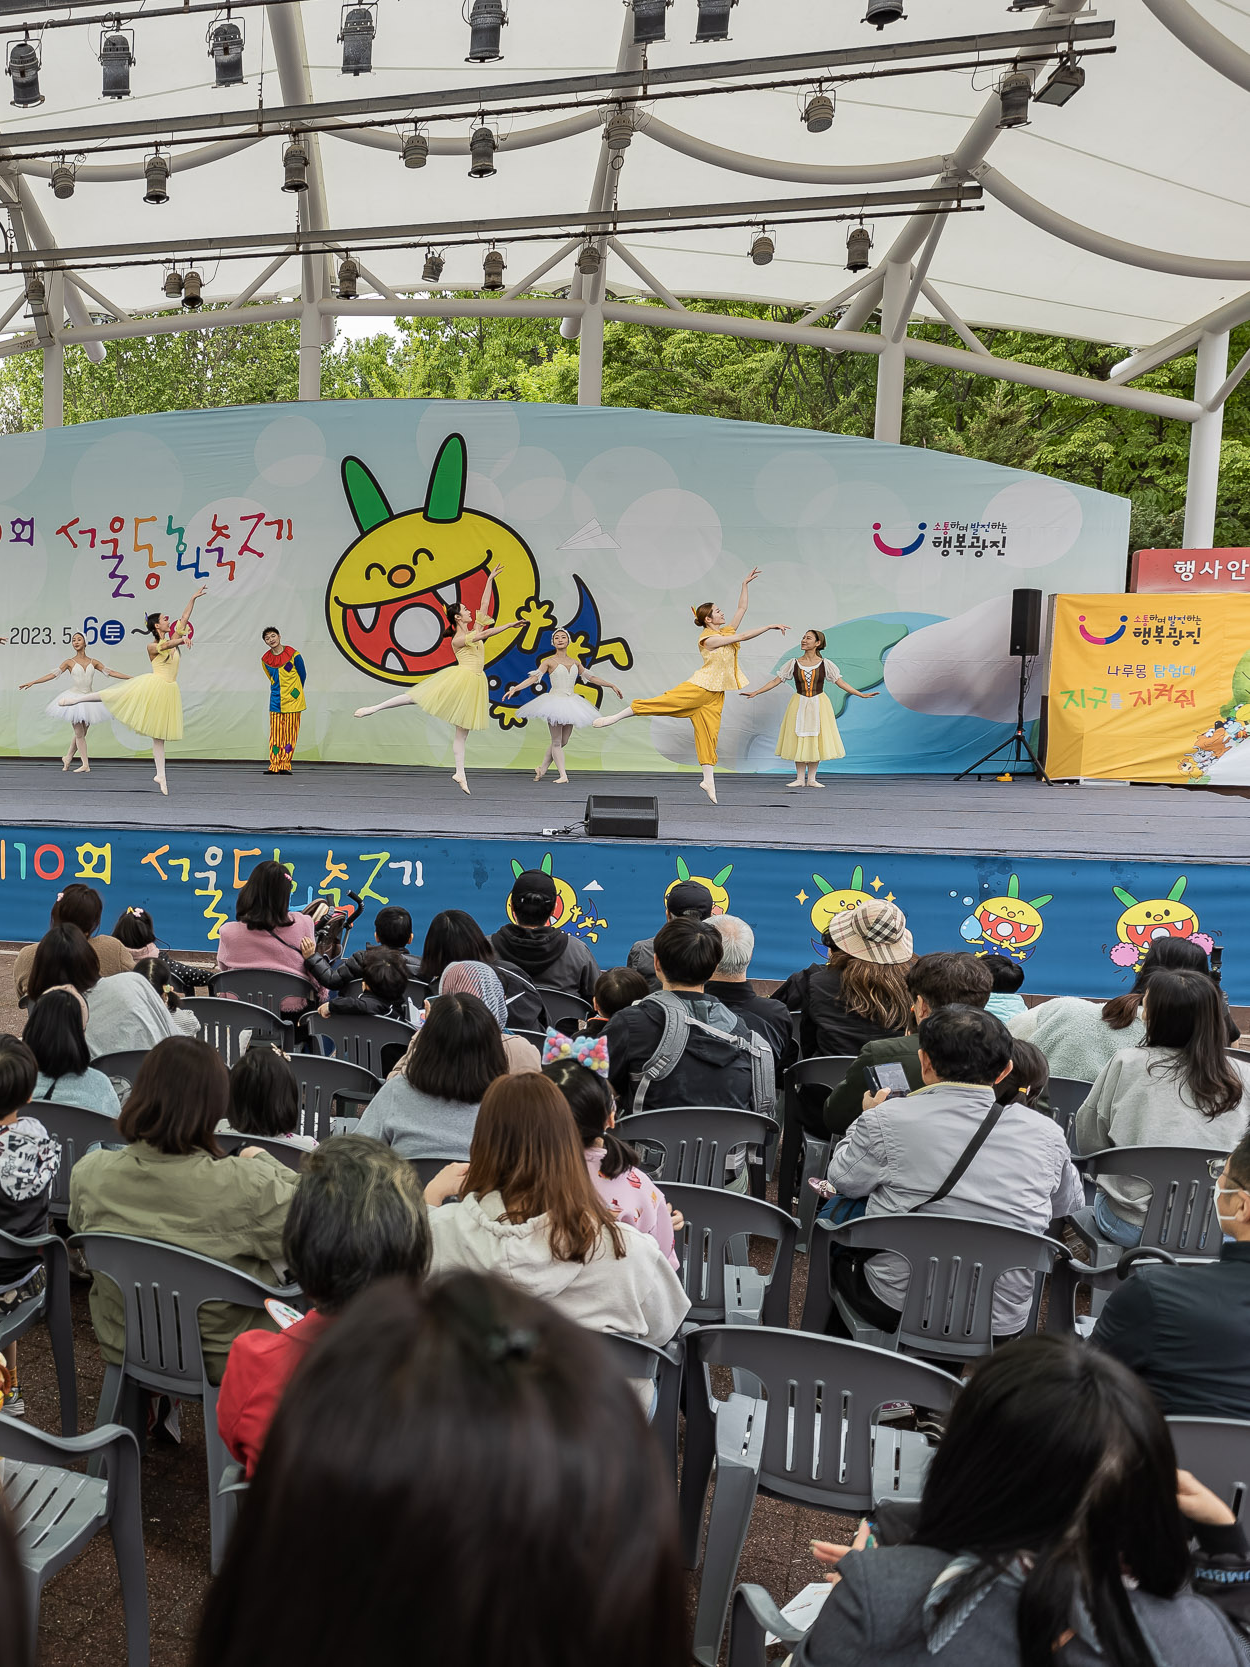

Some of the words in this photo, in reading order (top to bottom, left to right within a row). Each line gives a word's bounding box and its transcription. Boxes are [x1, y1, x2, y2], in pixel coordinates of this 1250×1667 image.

[933, 521, 968, 535] 소통하며
[970, 521, 1008, 535] 발전하는
[55, 512, 294, 599] 서울동화축제
[931, 534, 1008, 558] 행복광진
[1133, 614, 1166, 626] 소통하며
[9, 627, 56, 645] 2023.
[1133, 625, 1202, 646] 행복광진
[1107, 664, 1147, 679] 나루몽
[1153, 664, 1197, 679] 탐험대
[1129, 683, 1196, 709] 지켜줘
